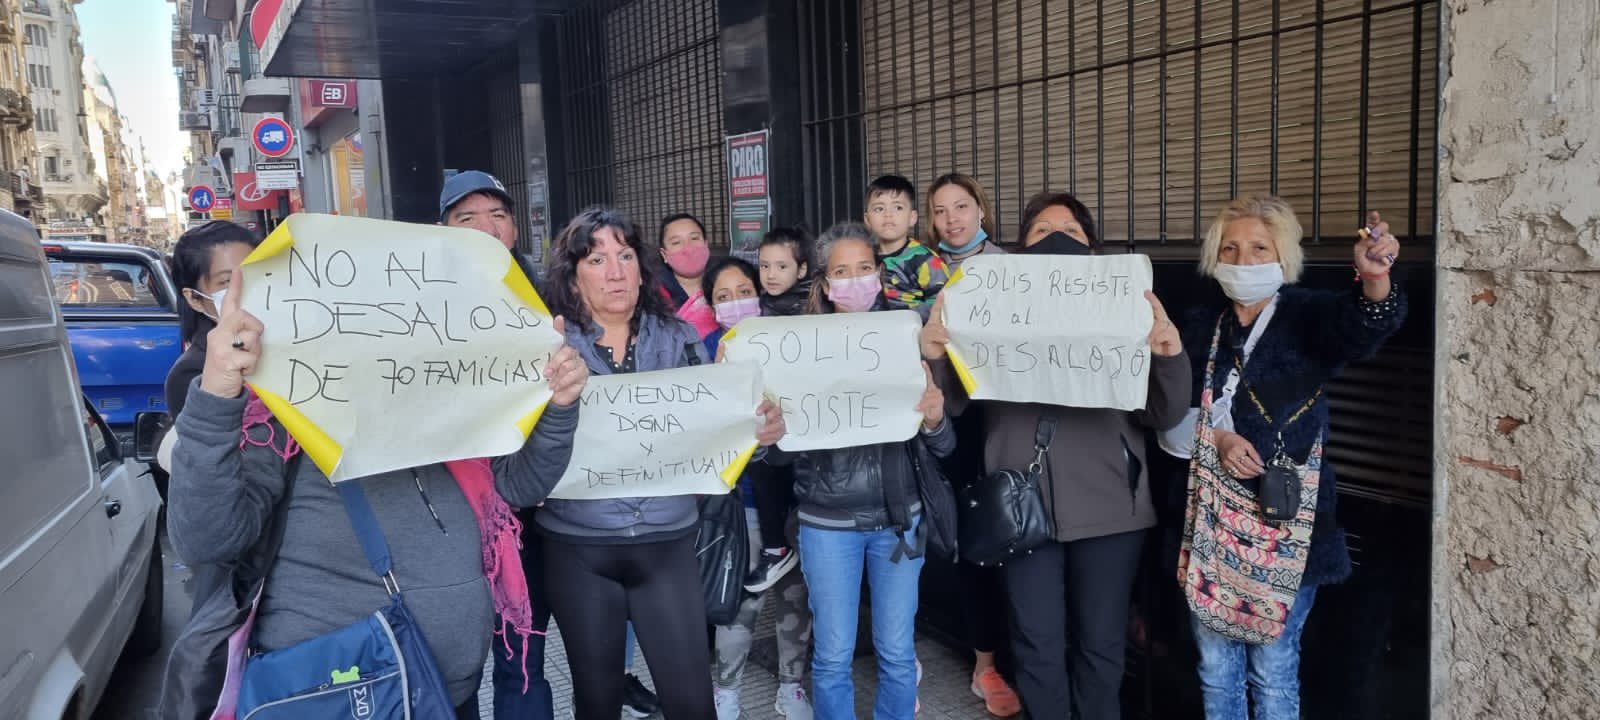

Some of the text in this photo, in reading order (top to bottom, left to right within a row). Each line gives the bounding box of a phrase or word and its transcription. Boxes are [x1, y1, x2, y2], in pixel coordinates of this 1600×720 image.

[731, 144, 764, 178] PARO
[384, 251, 457, 291] AL
[960, 266, 1130, 297] SOLIS RESISTE
[282, 298, 542, 345] DESALOJO
[747, 326, 881, 372] SOLIS
[969, 341, 1146, 379] DESALOJO
[289, 358, 350, 406] DE
[376, 358, 416, 394] 70
[763, 391, 880, 437] ESISTE
